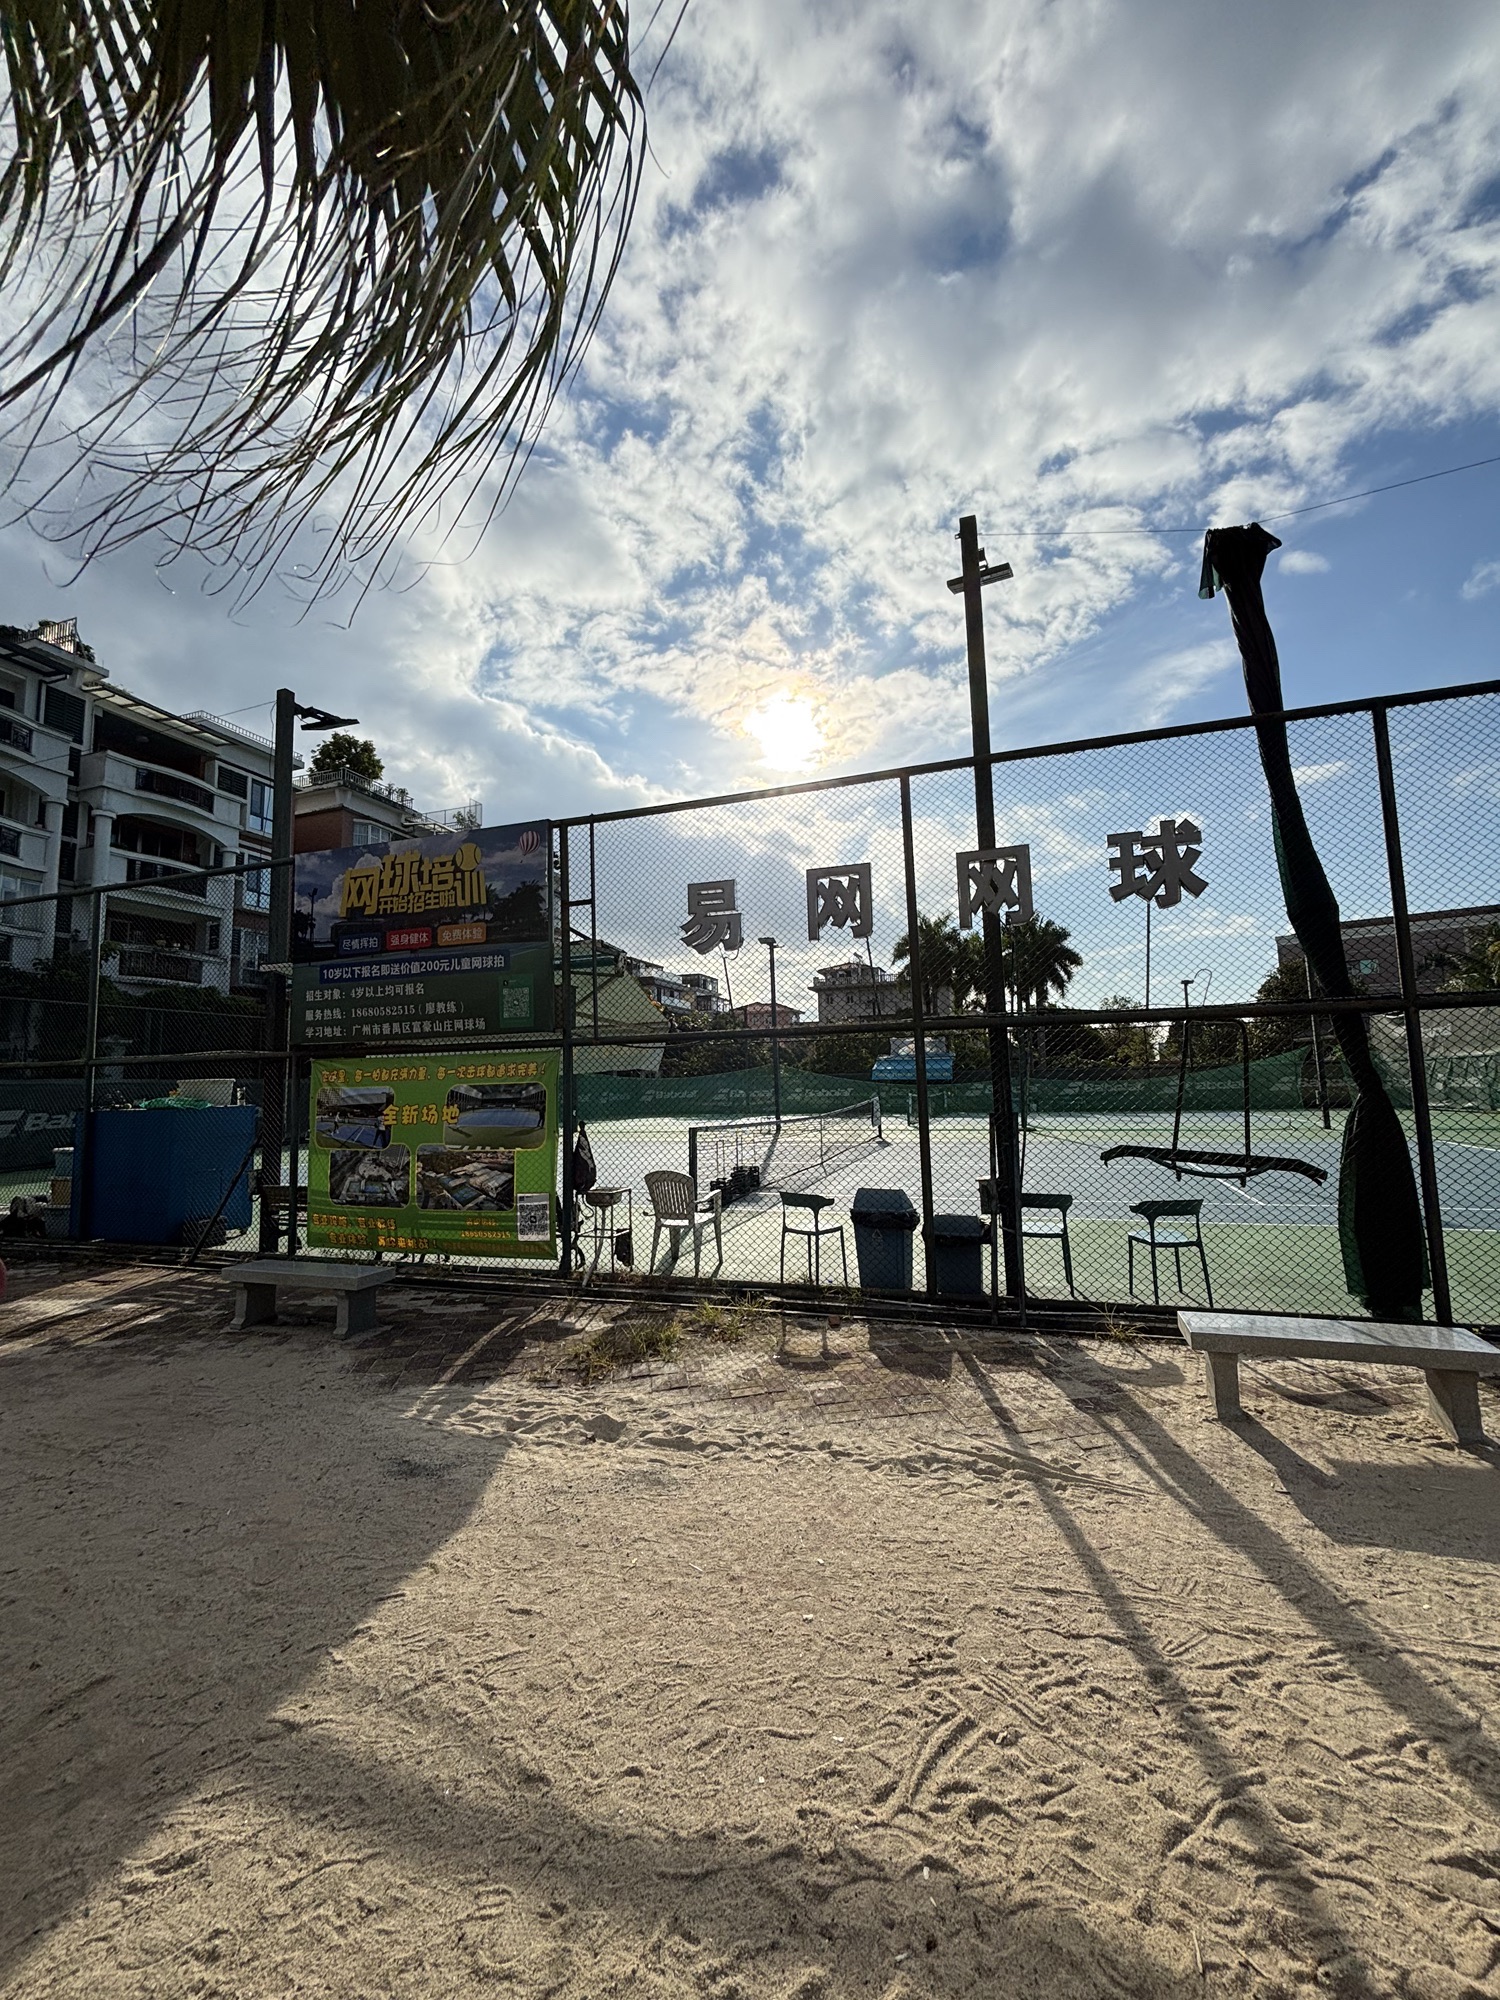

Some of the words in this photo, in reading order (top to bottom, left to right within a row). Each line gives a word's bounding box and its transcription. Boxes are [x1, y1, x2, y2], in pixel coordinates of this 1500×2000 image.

[339, 842, 488, 917] 网球培训
[379, 890, 456, 915] 开始招生啦
[342, 936, 379, 951] 尽情挥拍
[390, 931, 429, 947] 强身健体
[442, 926, 483, 942] 免费体验
[322, 955, 505, 980] 10岁以下报名即送价值200元儿童网球拍
[382, 1104, 460, 1126] 全新场地
